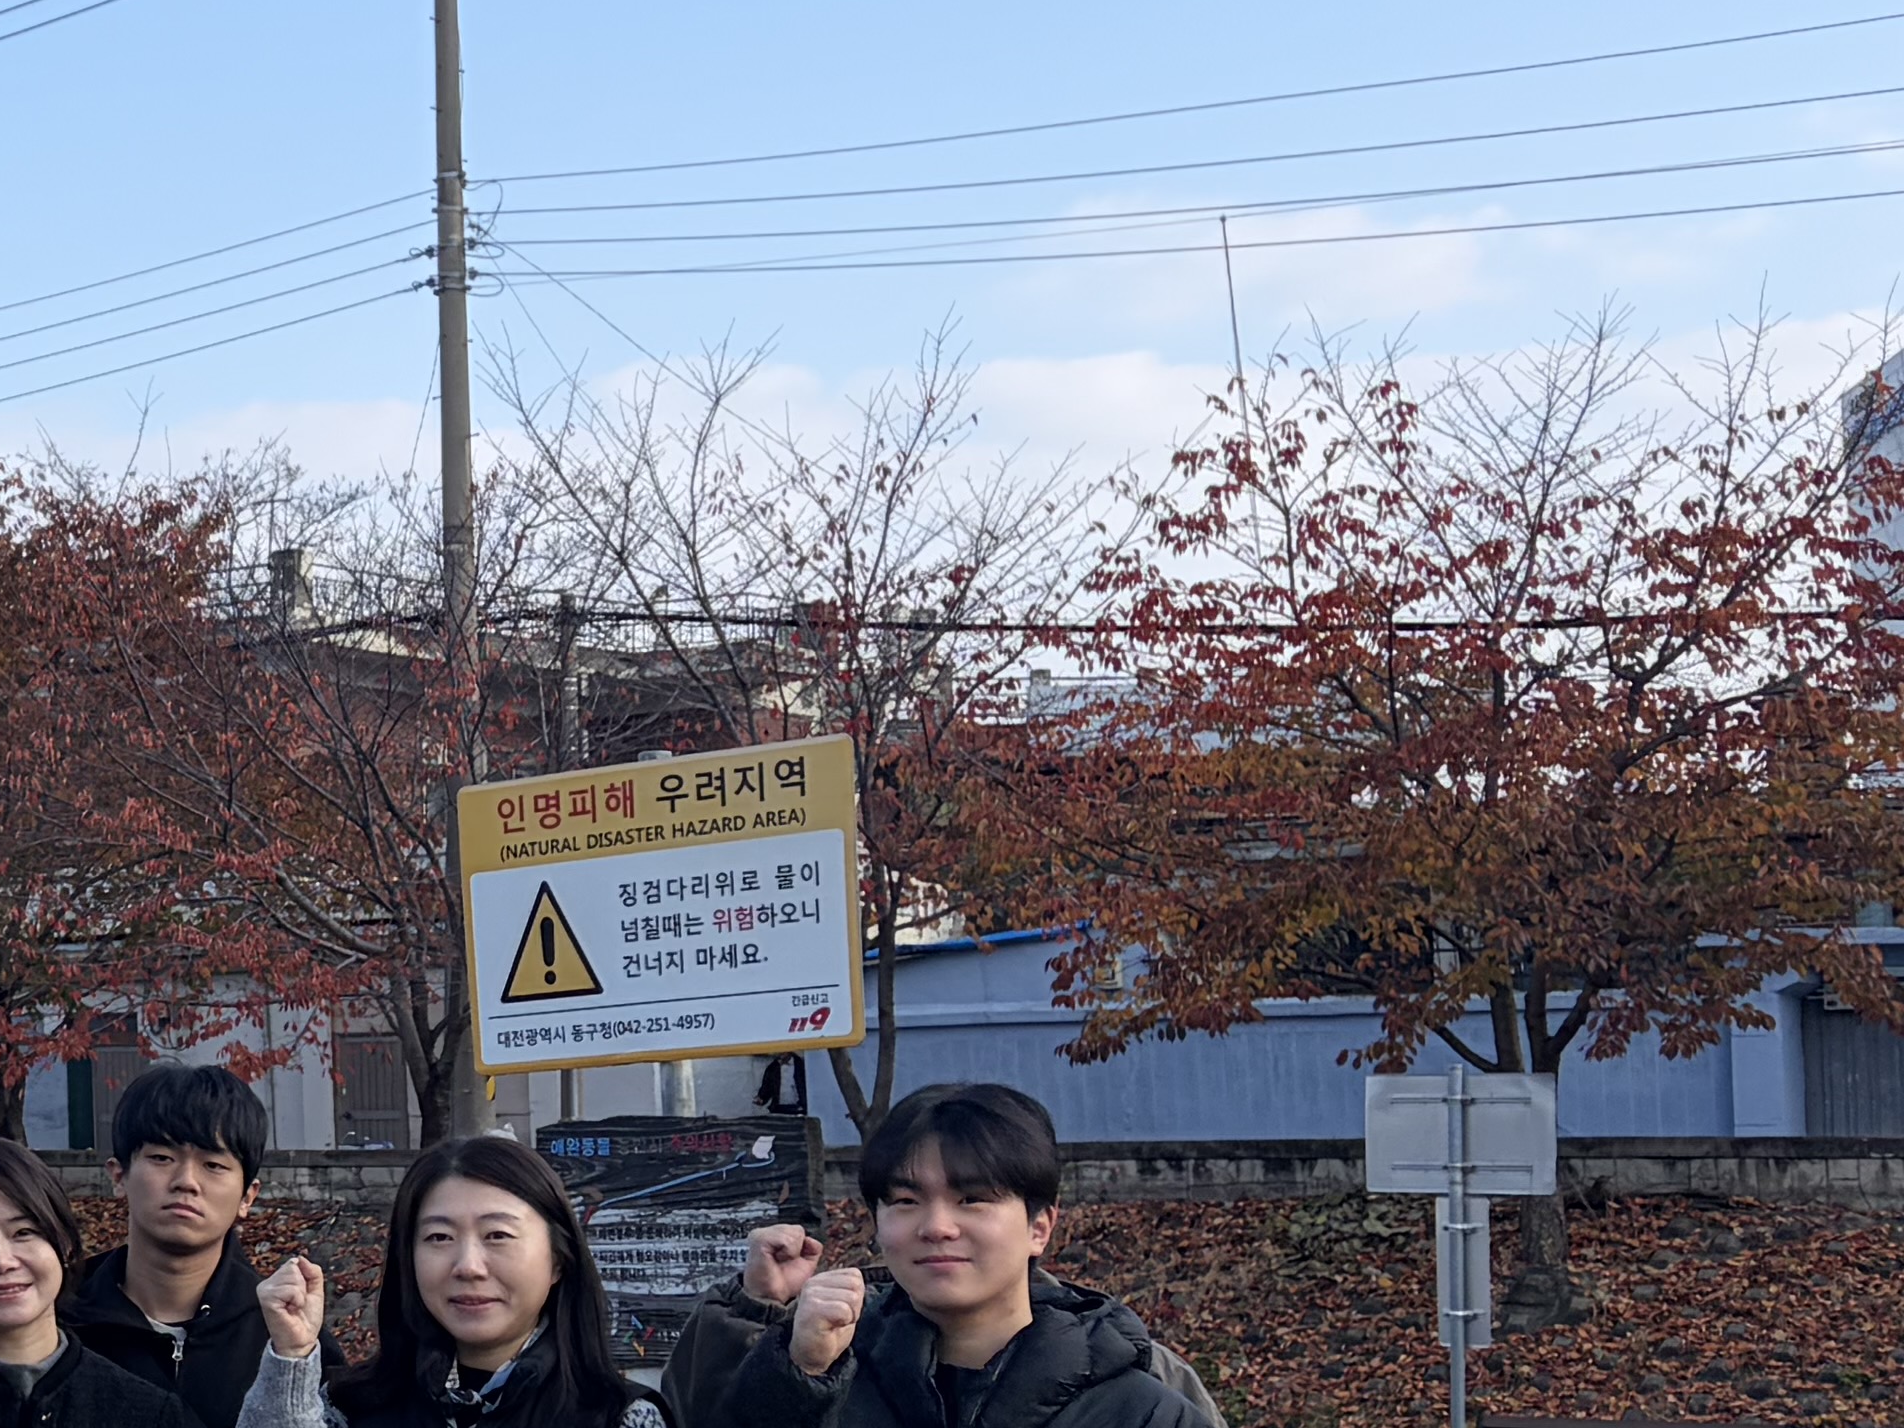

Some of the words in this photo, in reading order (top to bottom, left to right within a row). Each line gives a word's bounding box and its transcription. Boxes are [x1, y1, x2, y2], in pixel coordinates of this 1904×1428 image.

[497, 779, 635, 834] 인명피해
[655, 756, 806, 813] 우려지역
[499, 836, 581, 863] (NATURAL
[586, 825, 666, 850] DISASTER
[672, 815, 746, 839] HAZARD
[752, 807, 806, 830] AREA)
[618, 870, 761, 907] 징검다리위로
[774, 860, 820, 891] 물이
[620, 913, 705, 944] 넘칠때는
[711, 898, 821, 933] 위험하오니
[622, 948, 685, 978] 건너지
[695, 943, 769, 972] 마세요.
[497, 1025, 567, 1049] 대전광역시
[788, 1006, 832, 1033] 119
